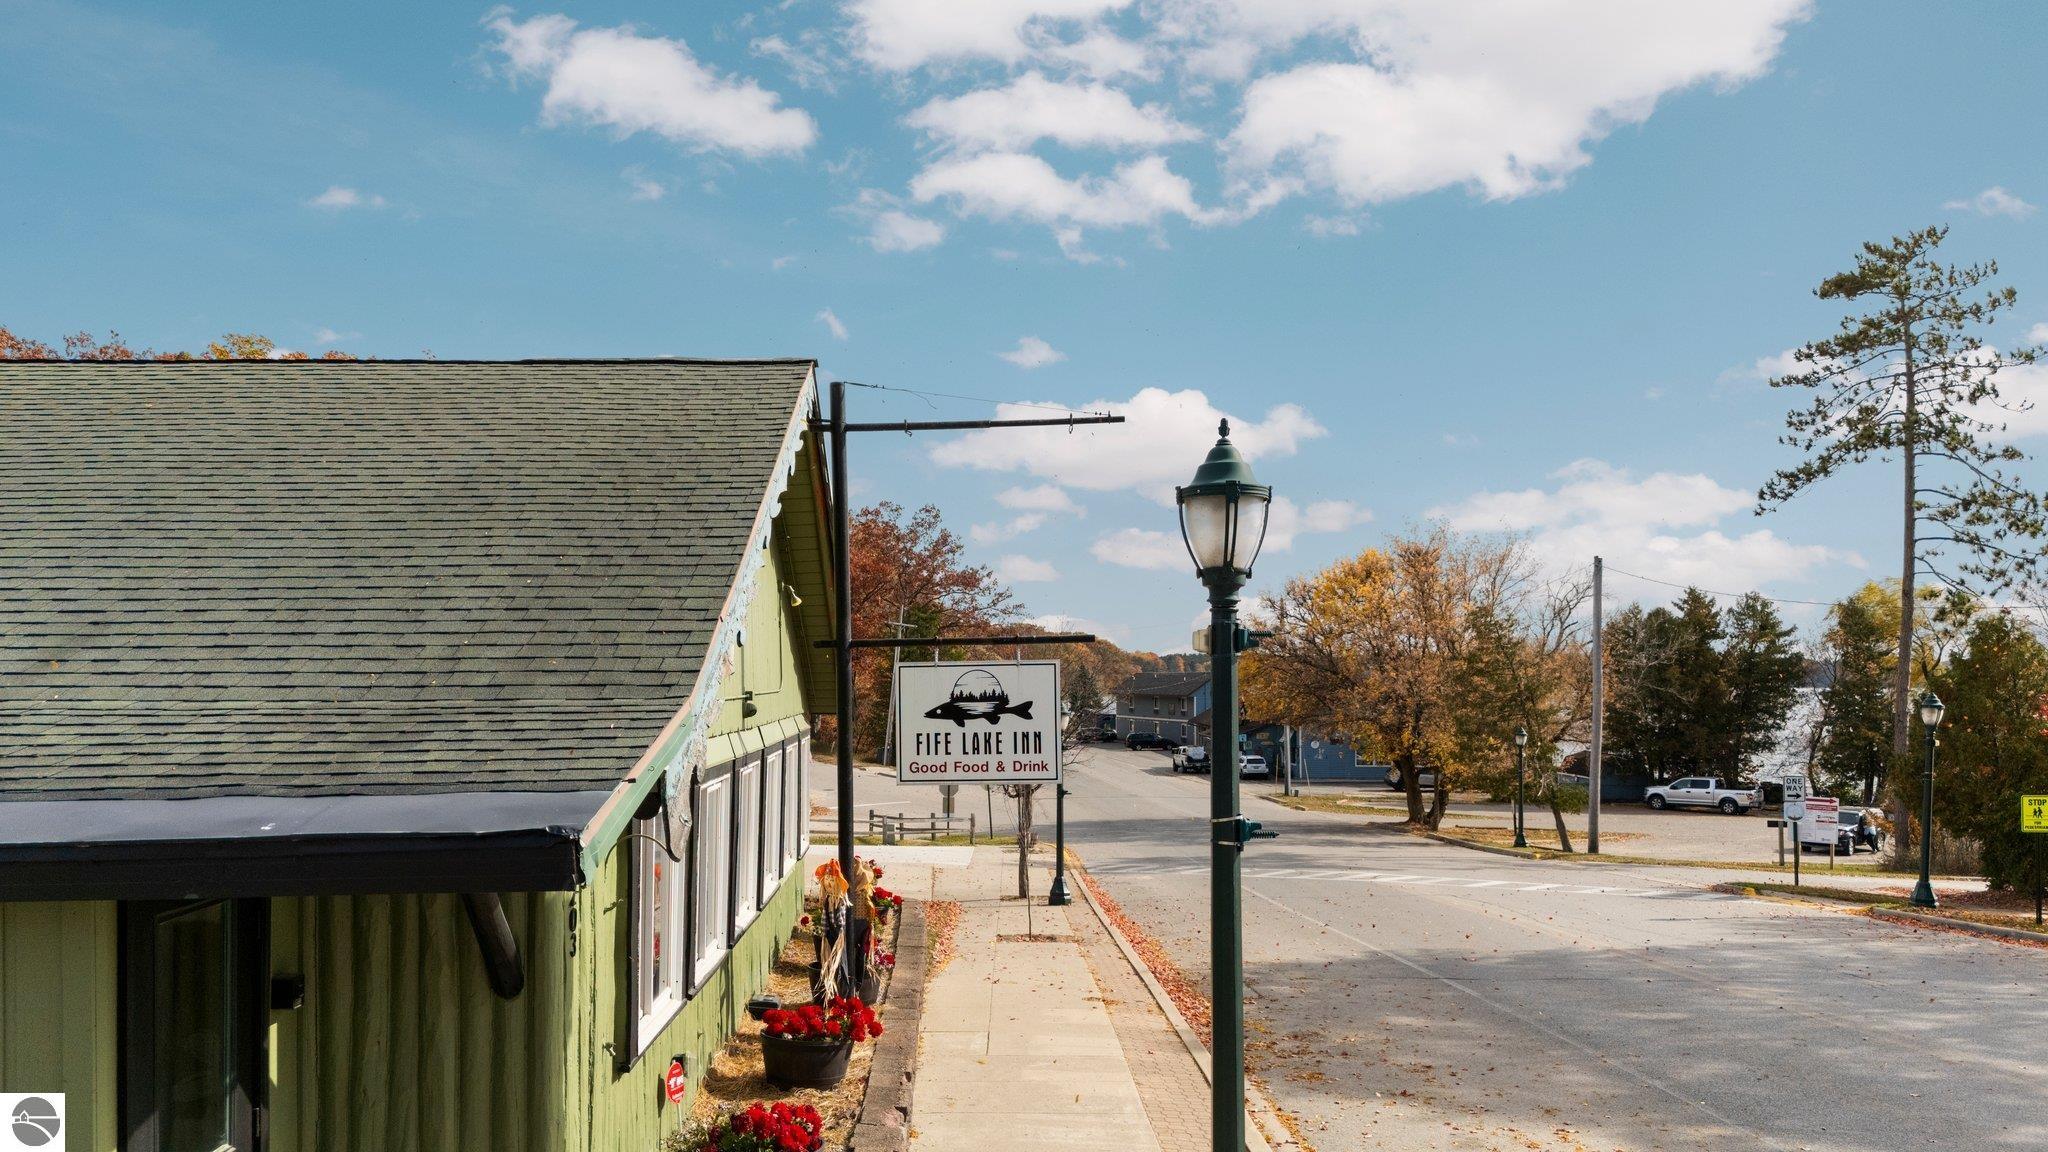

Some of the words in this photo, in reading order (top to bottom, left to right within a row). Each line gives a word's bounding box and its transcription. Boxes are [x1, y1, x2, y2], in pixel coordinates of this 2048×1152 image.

[916, 732, 951, 755] FIFE
[962, 731, 1002, 755] LAKE
[1013, 731, 1042, 754] INN
[909, 762, 947, 773] Good
[954, 761, 989, 773] Food
[996, 761, 1005, 772] &
[1013, 760, 1049, 772] Drink
